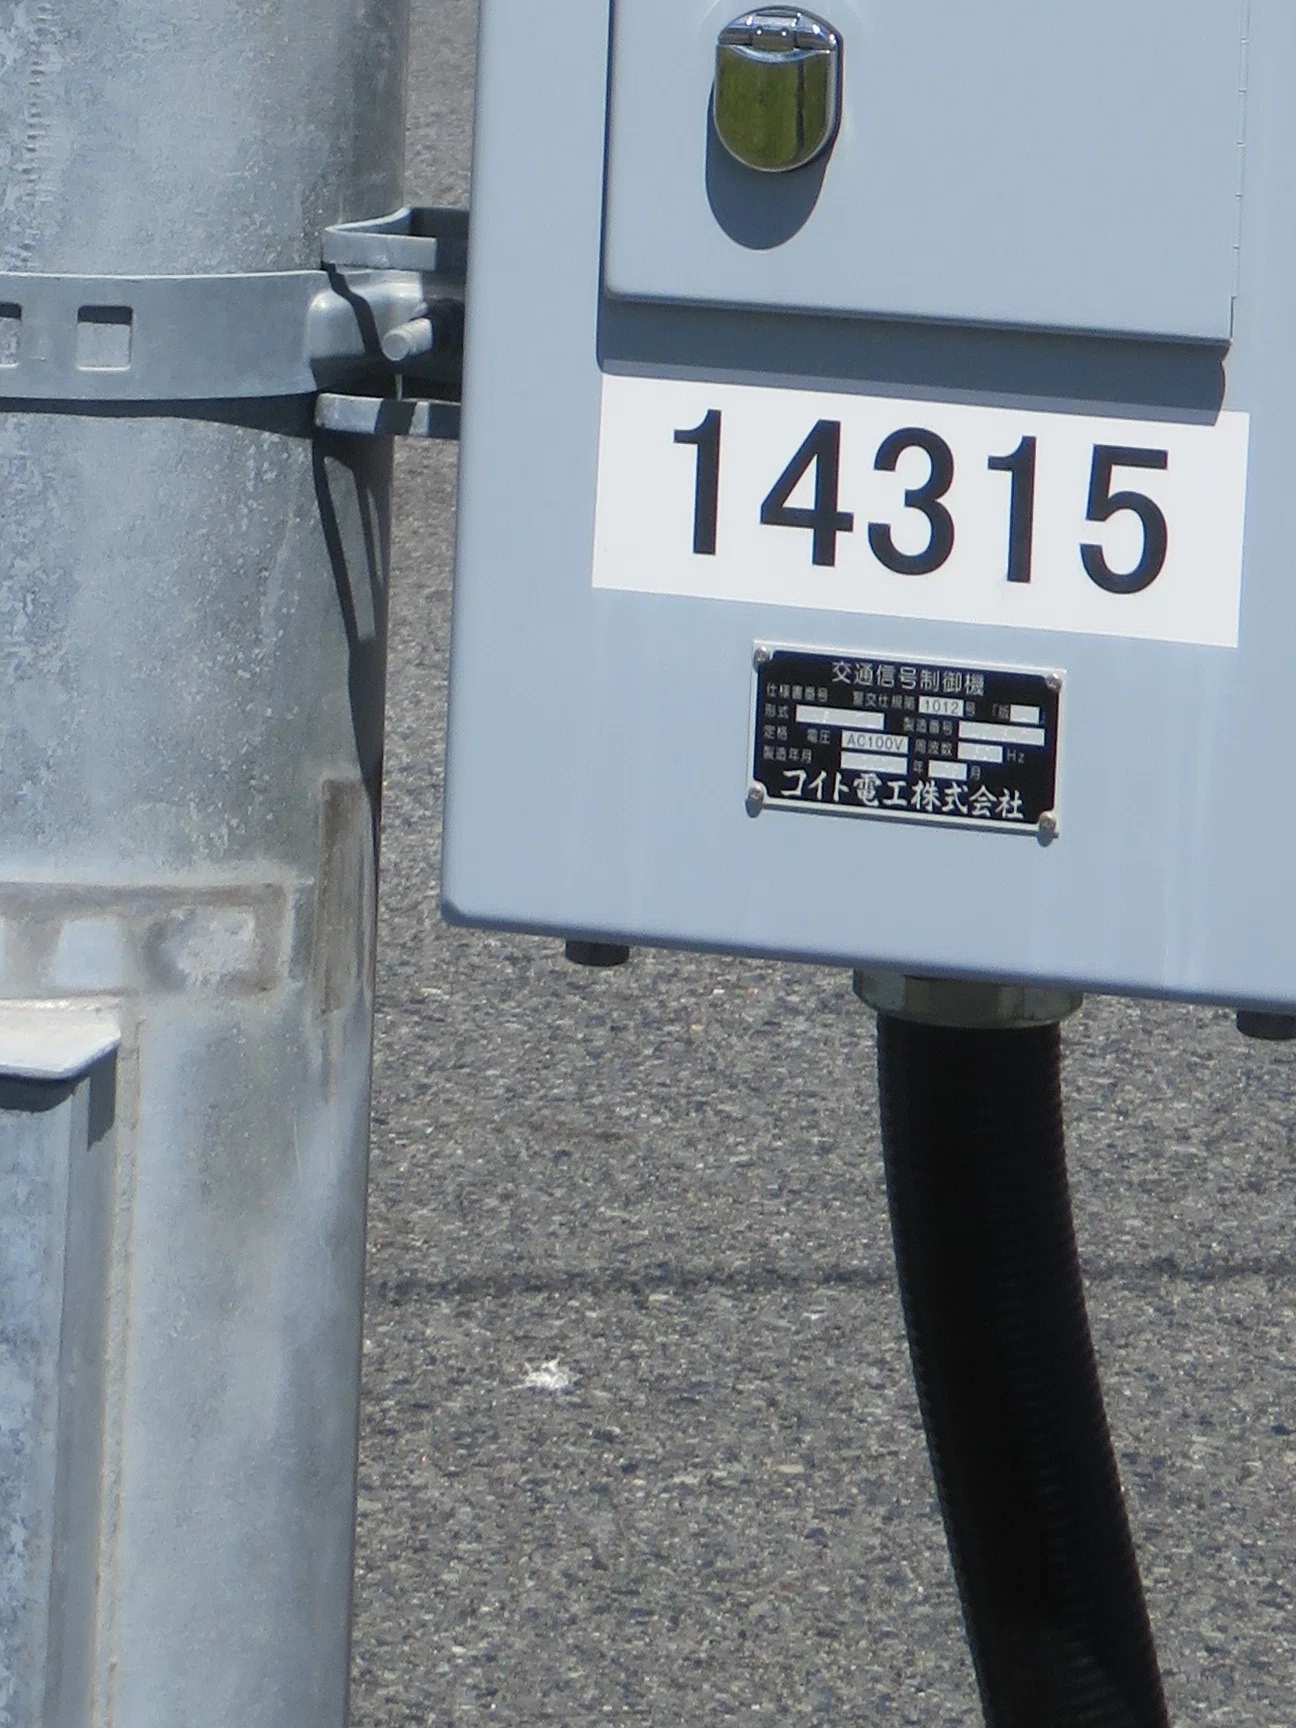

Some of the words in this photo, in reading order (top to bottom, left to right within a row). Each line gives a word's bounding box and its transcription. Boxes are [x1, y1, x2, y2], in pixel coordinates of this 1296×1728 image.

[673, 409, 1169, 595] 14315
[831, 660, 985, 697] 交通信号制御機
[764, 703, 789, 720] 形式
[763, 724, 788, 742] 定格
[806, 727, 832, 745] 電圧
[846, 735, 905, 752] AC100V
[1007, 748, 1025, 764] Hz
[969, 765, 981, 781] 月
[780, 769, 1025, 820] コイト電工株式会社
